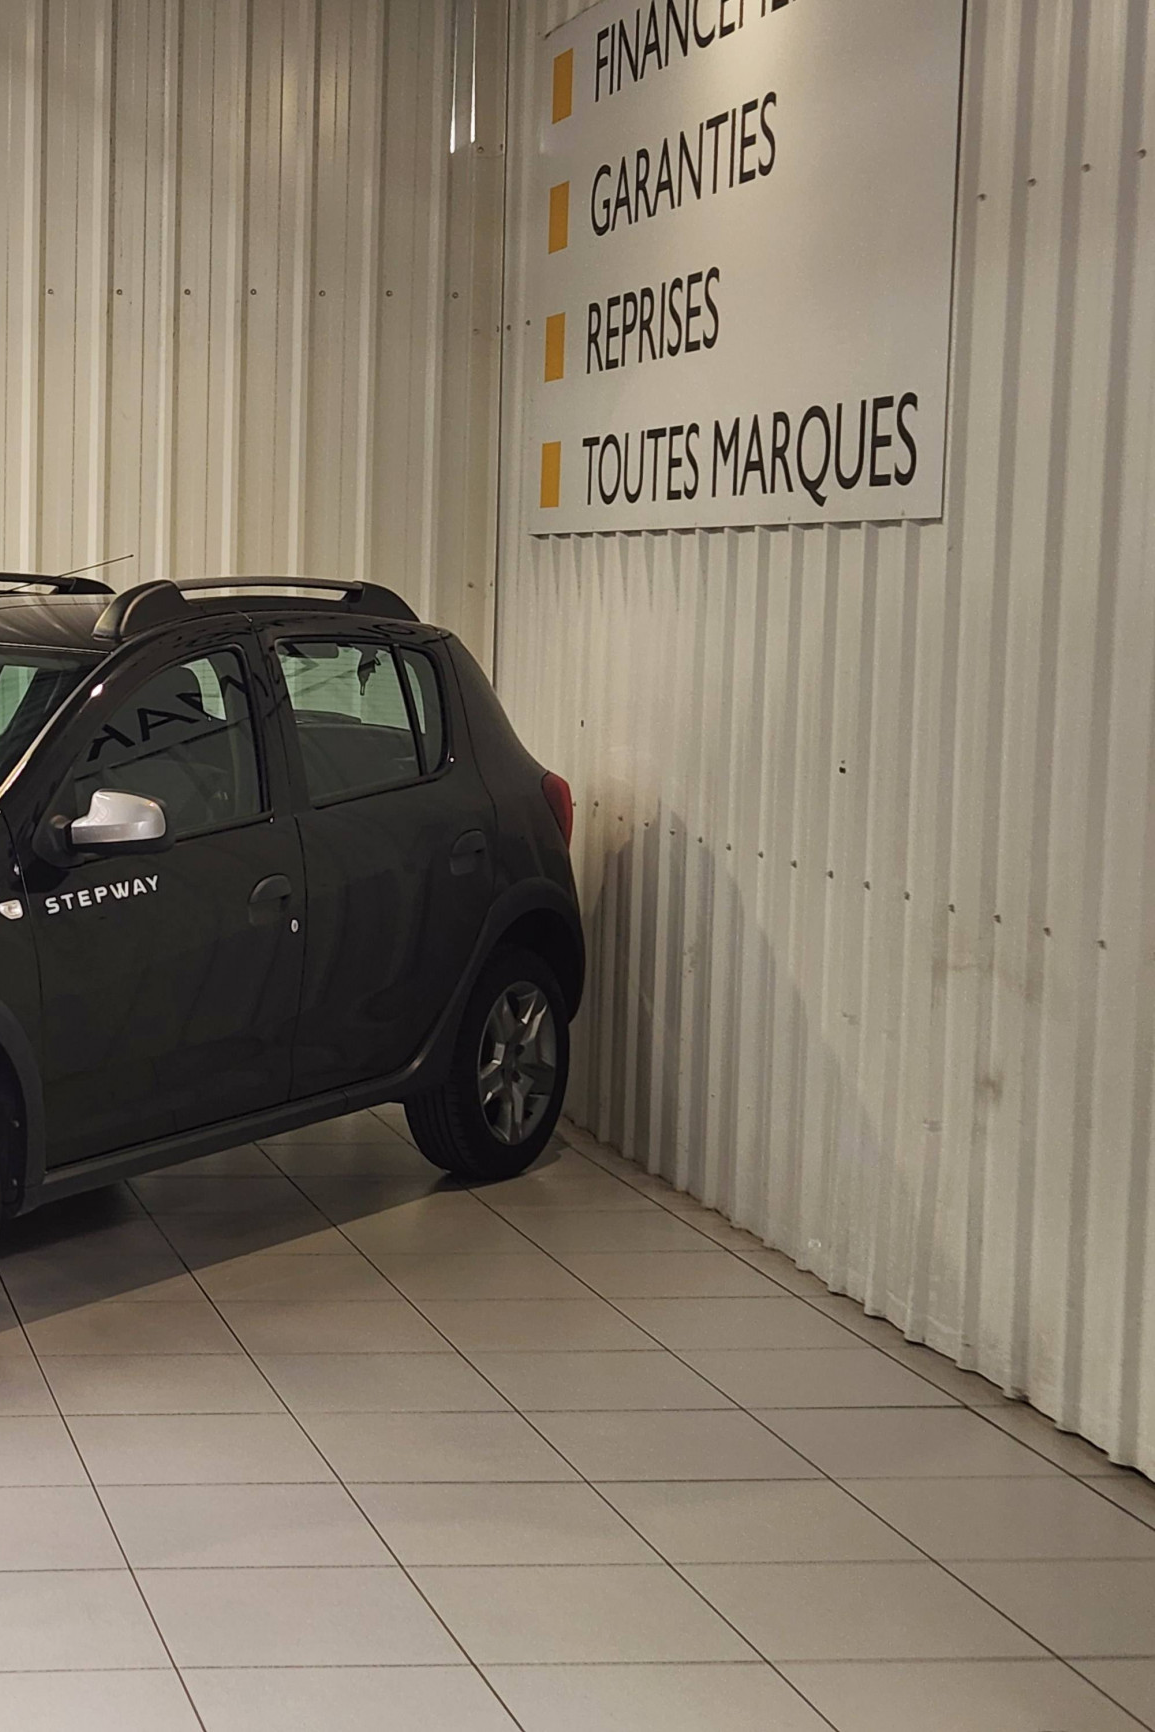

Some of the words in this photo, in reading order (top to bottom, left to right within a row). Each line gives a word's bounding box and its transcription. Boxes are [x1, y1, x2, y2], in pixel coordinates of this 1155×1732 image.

[595, 0, 791, 102] FINANC
[590, 91, 777, 236] GARANTIES
[586, 267, 720, 374] REPRISES
[582, 423, 700, 505] TOUTES
[711, 392, 918, 507] MARQUES
[45, 875, 160, 915] STEPWAY
